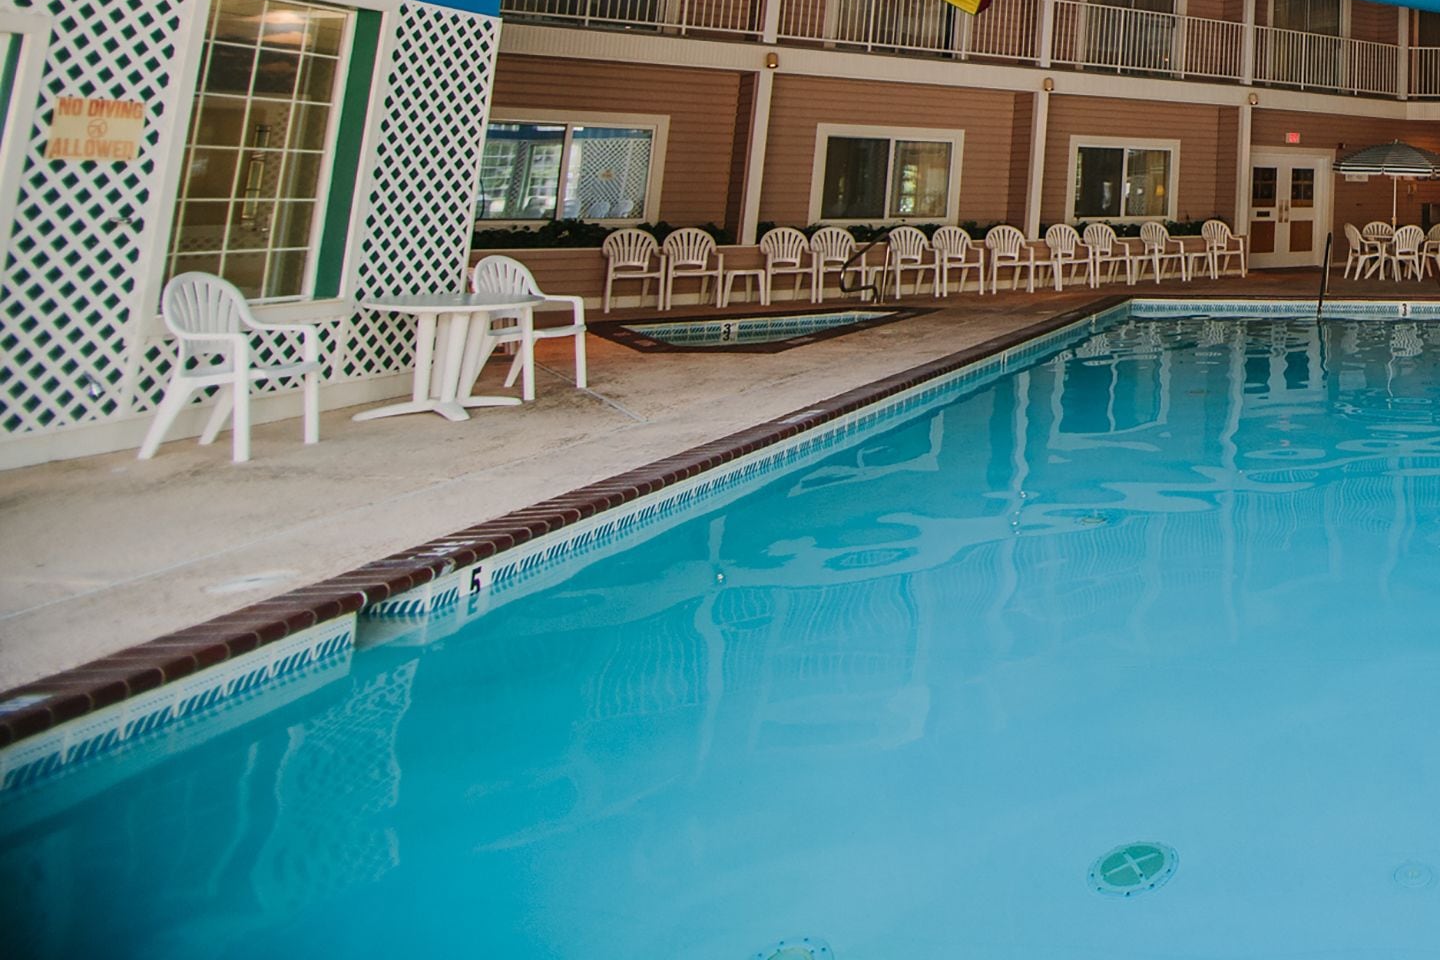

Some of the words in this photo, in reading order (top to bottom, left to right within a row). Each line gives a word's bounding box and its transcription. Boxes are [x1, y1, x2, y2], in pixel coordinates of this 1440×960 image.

[58, 97, 83, 116] NO
[87, 99, 144, 119] DIVING
[49, 138, 135, 159] ALLOWED
[1402, 303, 1407, 316] 3
[470, 566, 481, 596] 5
